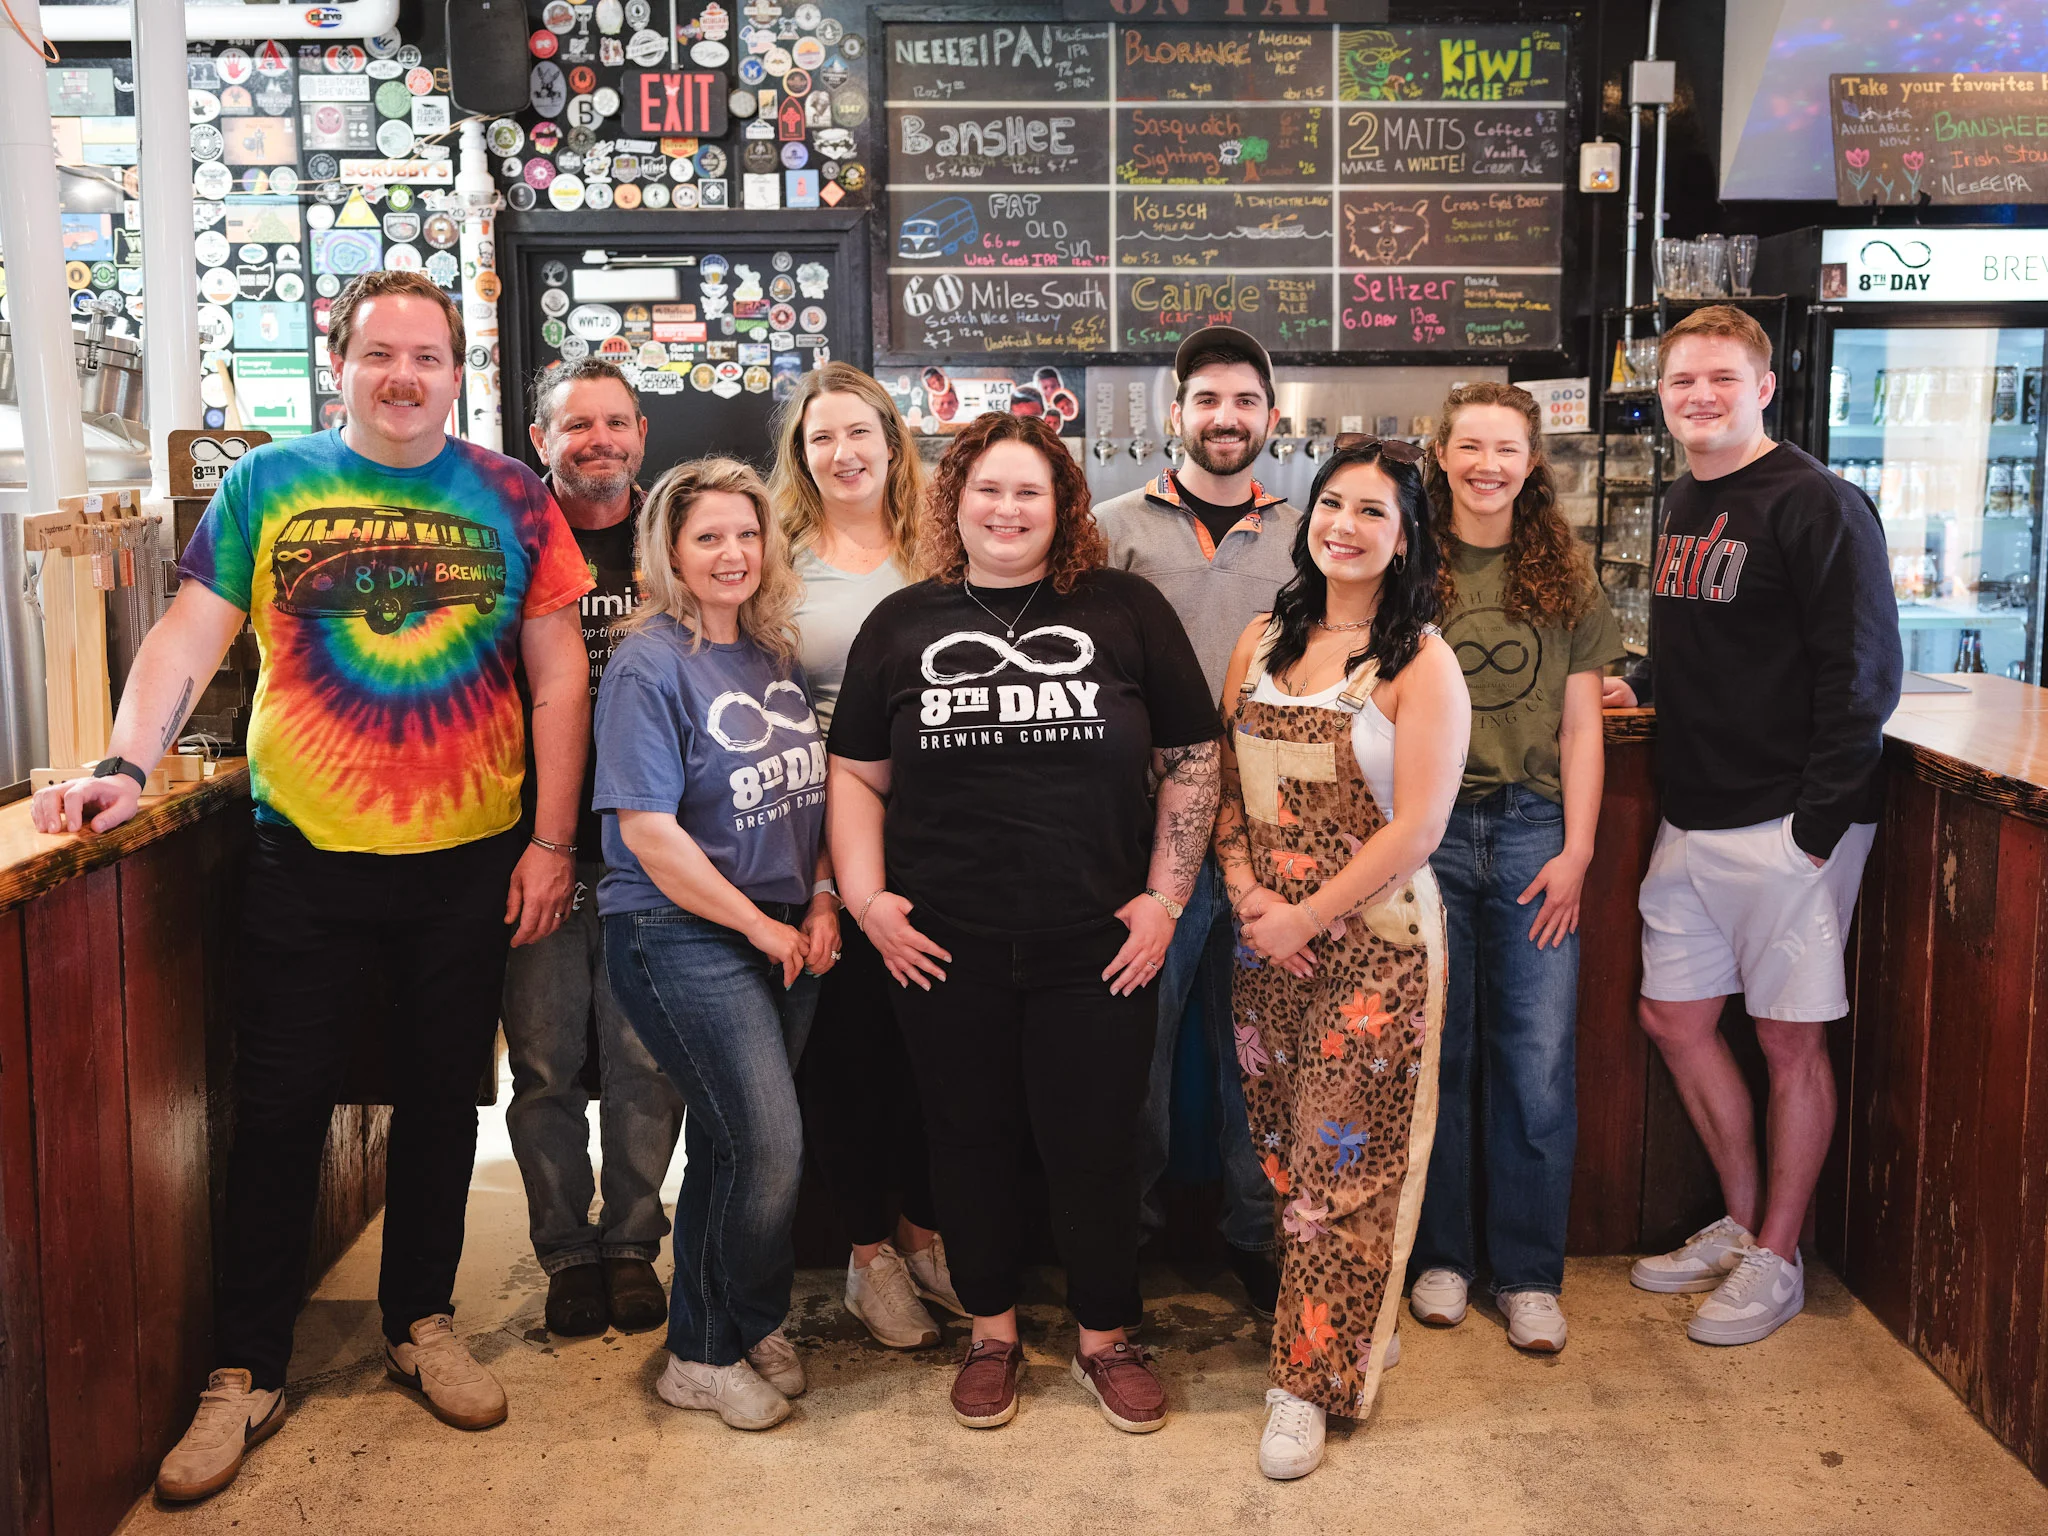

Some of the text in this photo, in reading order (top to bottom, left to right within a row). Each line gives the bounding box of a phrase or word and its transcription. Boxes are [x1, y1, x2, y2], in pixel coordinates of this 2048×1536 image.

[1067, 44, 1089, 60] IPA
[1440, 37, 1532, 84] Kiwi
[1274, 64, 1297, 76] ALE
[1841, 76, 1889, 97] Take
[1900, 80, 1946, 104] your
[1949, 73, 2035, 94] favorites
[639, 73, 715, 132] EXIT
[1133, 109, 1242, 143] Sasquatch
[1384, 117, 1467, 151] MATTS
[1474, 120, 1535, 137] Coffee
[1841, 122, 1911, 136] AVAILABLE
[1879, 136, 1912, 148] NOW
[345, 163, 449, 178] SCRUBBY'S
[1341, 158, 1388, 175] MAKE
[1951, 149, 2001, 170] Irish
[988, 192, 1041, 219] FAT
[1025, 220, 1068, 239] OLD
[1131, 274, 1261, 313] Cairde
[1351, 272, 1456, 303] Seltzer
[1889, 273, 1932, 291] DAY
[971, 279, 1040, 311] Miles
[1041, 278, 1108, 311] South
[1276, 301, 1309, 315] ALE
[924, 311, 978, 328] Scotch
[1016, 310, 1062, 331] Heavy
[983, 383, 1012, 396] LAST
[388, 561, 428, 590] DAY
[435, 562, 507, 584] BREWING
[919, 680, 1100, 727] 8TH DAY
[920, 725, 1106, 750] BREWING COMPANY
[781, 740, 829, 791] DA
